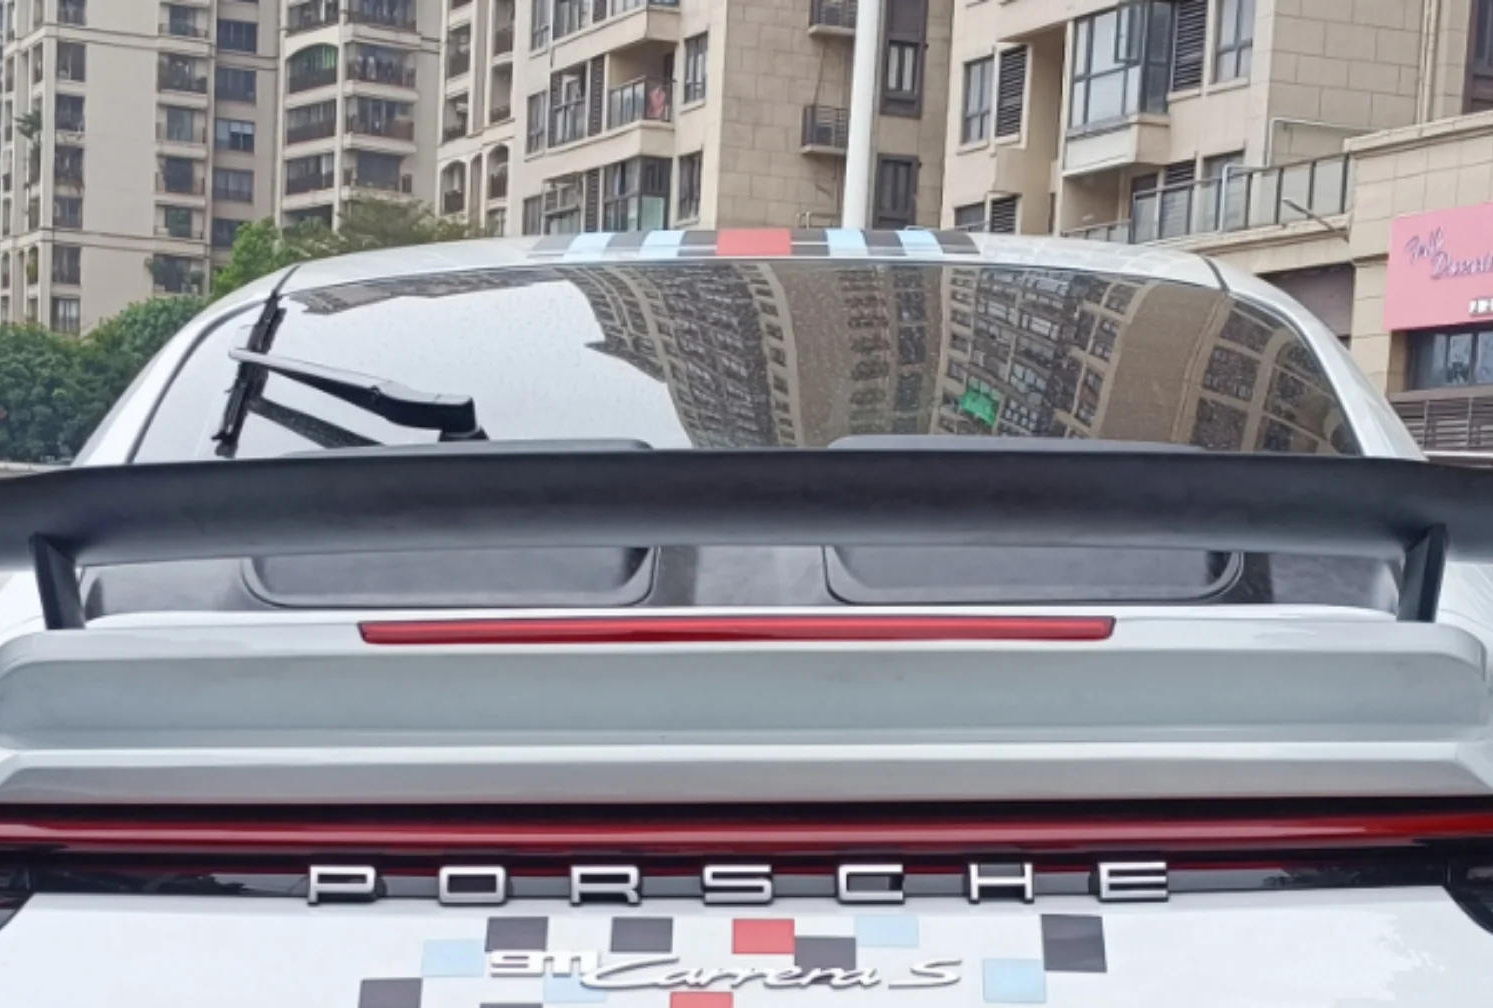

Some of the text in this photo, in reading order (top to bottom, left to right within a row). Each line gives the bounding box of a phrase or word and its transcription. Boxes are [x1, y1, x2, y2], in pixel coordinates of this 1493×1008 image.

[308, 862, 1168, 906] PORSCHE
[491, 949, 962, 990] 911 Carrera S
